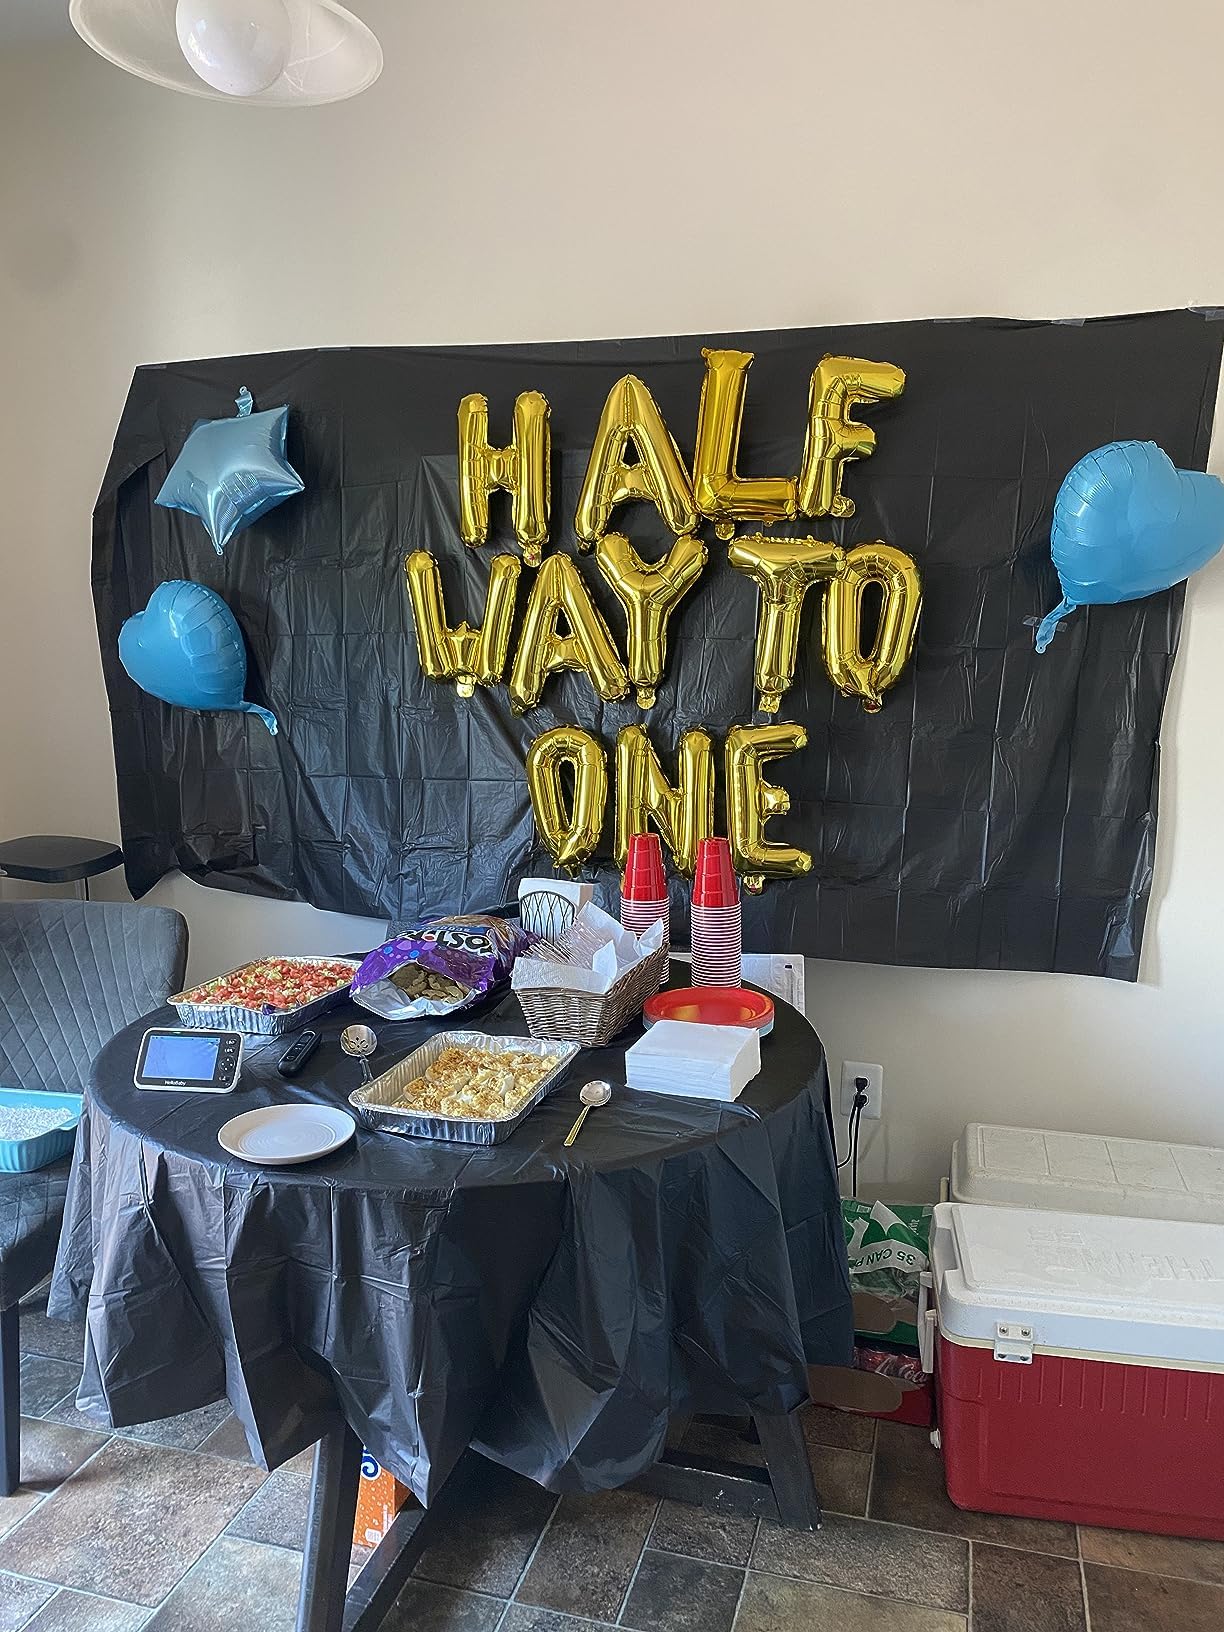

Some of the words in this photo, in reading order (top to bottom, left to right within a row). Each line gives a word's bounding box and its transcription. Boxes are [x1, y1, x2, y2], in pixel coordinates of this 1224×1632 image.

[457, 348, 906, 562] HALF
[404, 532, 708, 713] WAY
[728, 533, 922, 713] TO
[527, 724, 814, 888] ONE
[866, 1248, 893, 1266] CAN
[896, 1250, 916, 1266] 35
